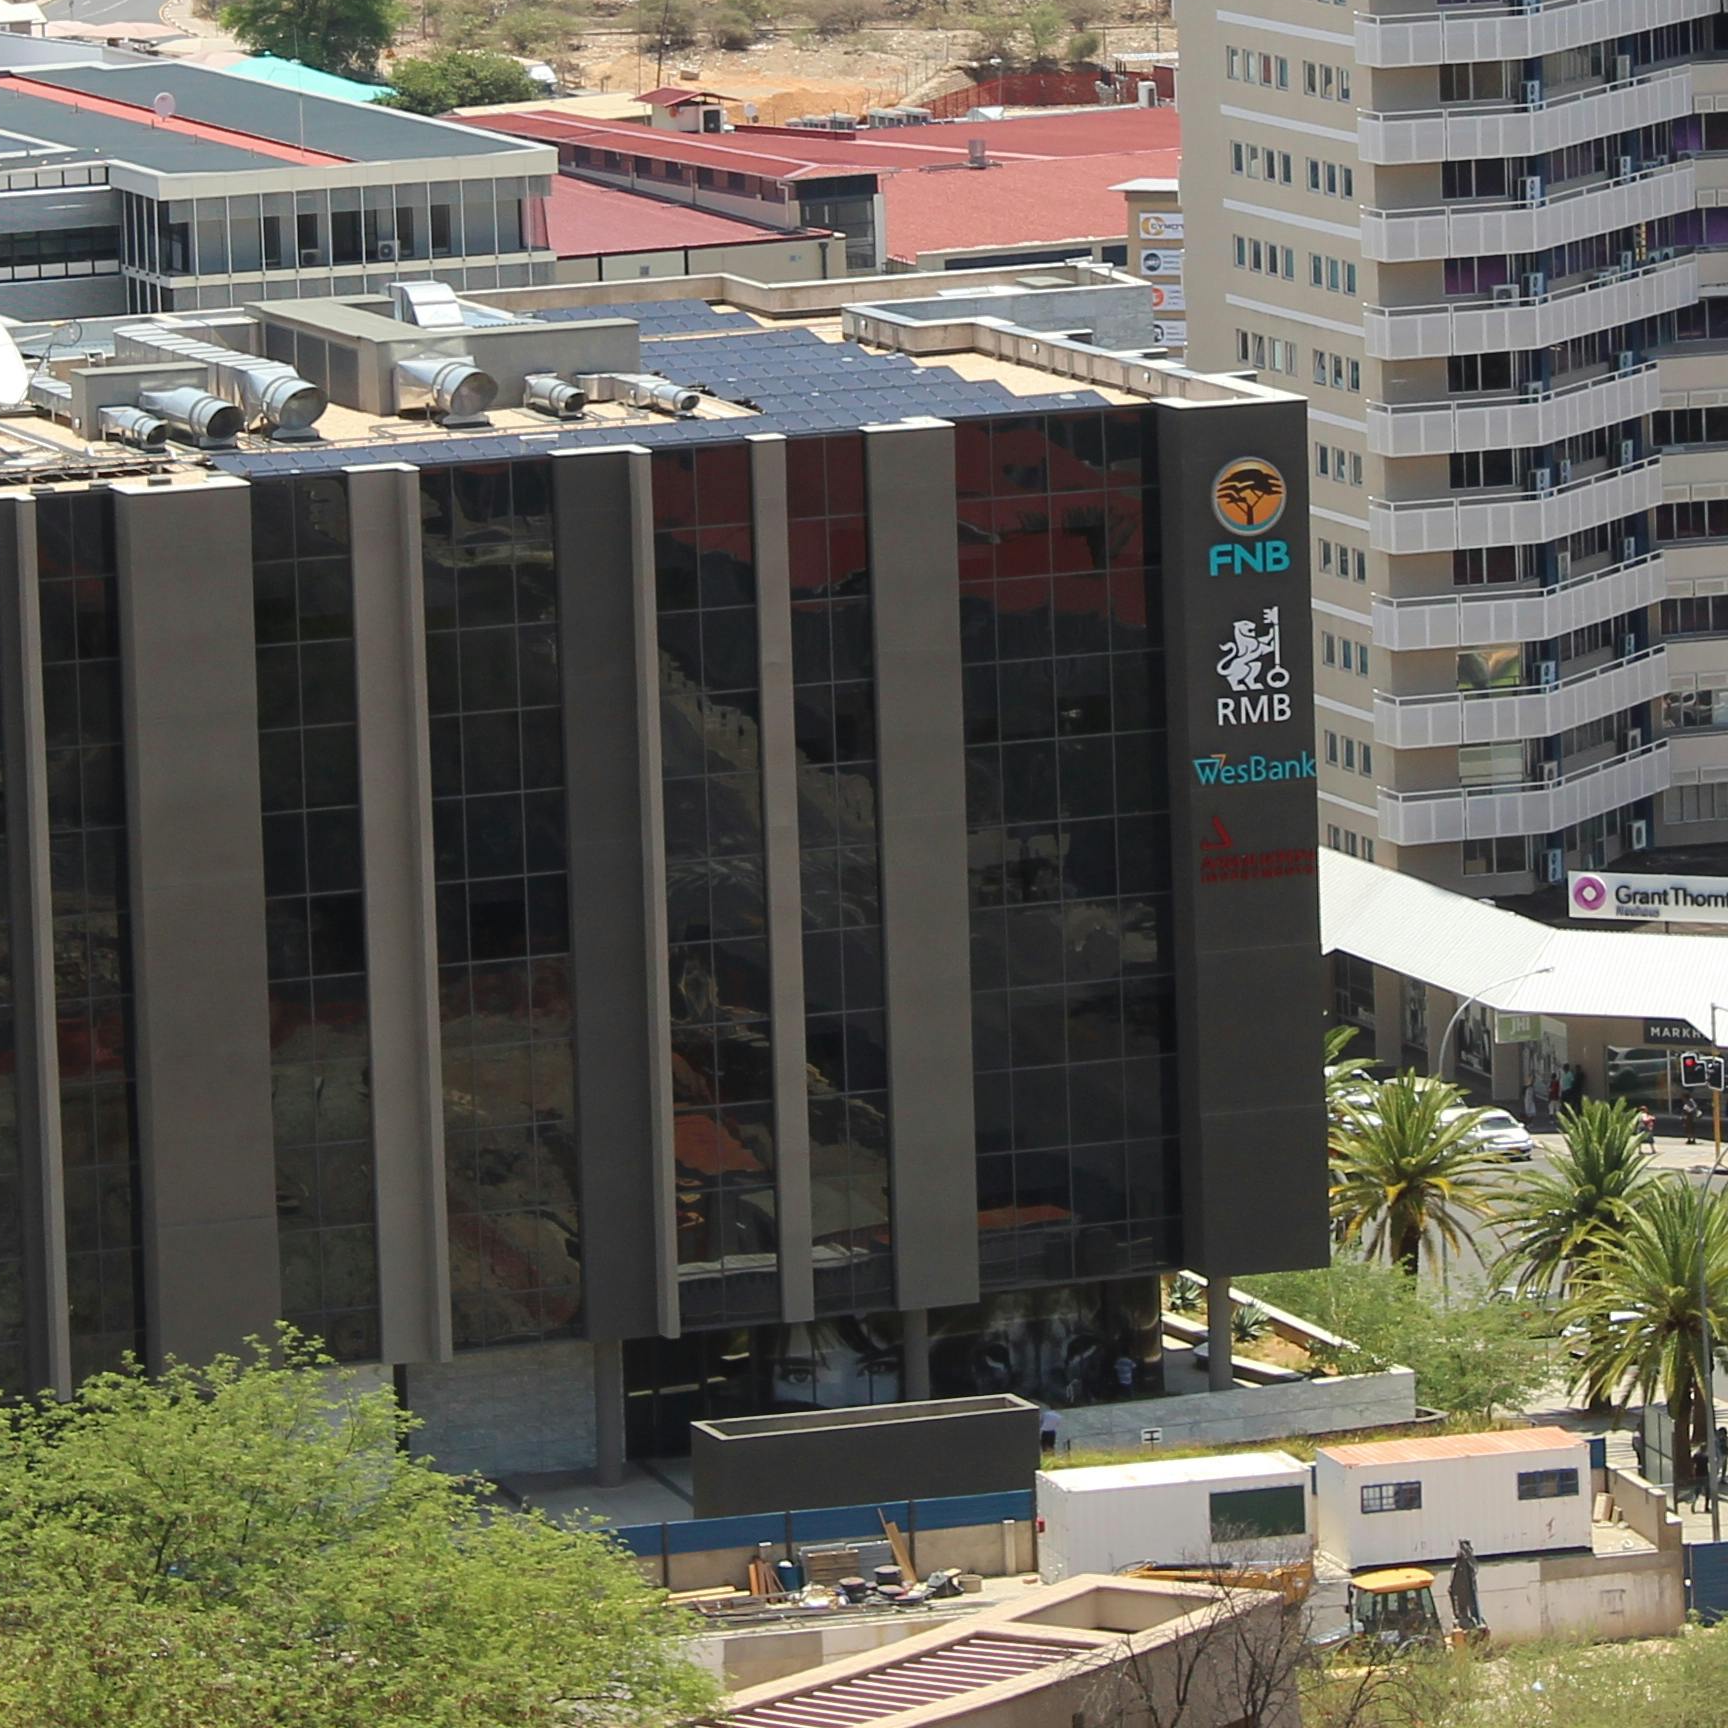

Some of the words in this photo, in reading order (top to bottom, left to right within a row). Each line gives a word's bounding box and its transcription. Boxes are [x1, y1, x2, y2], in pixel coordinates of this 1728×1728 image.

[1209, 540, 1290, 576] FNB
[1217, 693, 1292, 725] RMB
[1192, 750, 1317, 785] WesBank
[1615, 885, 1669, 906] Grant
